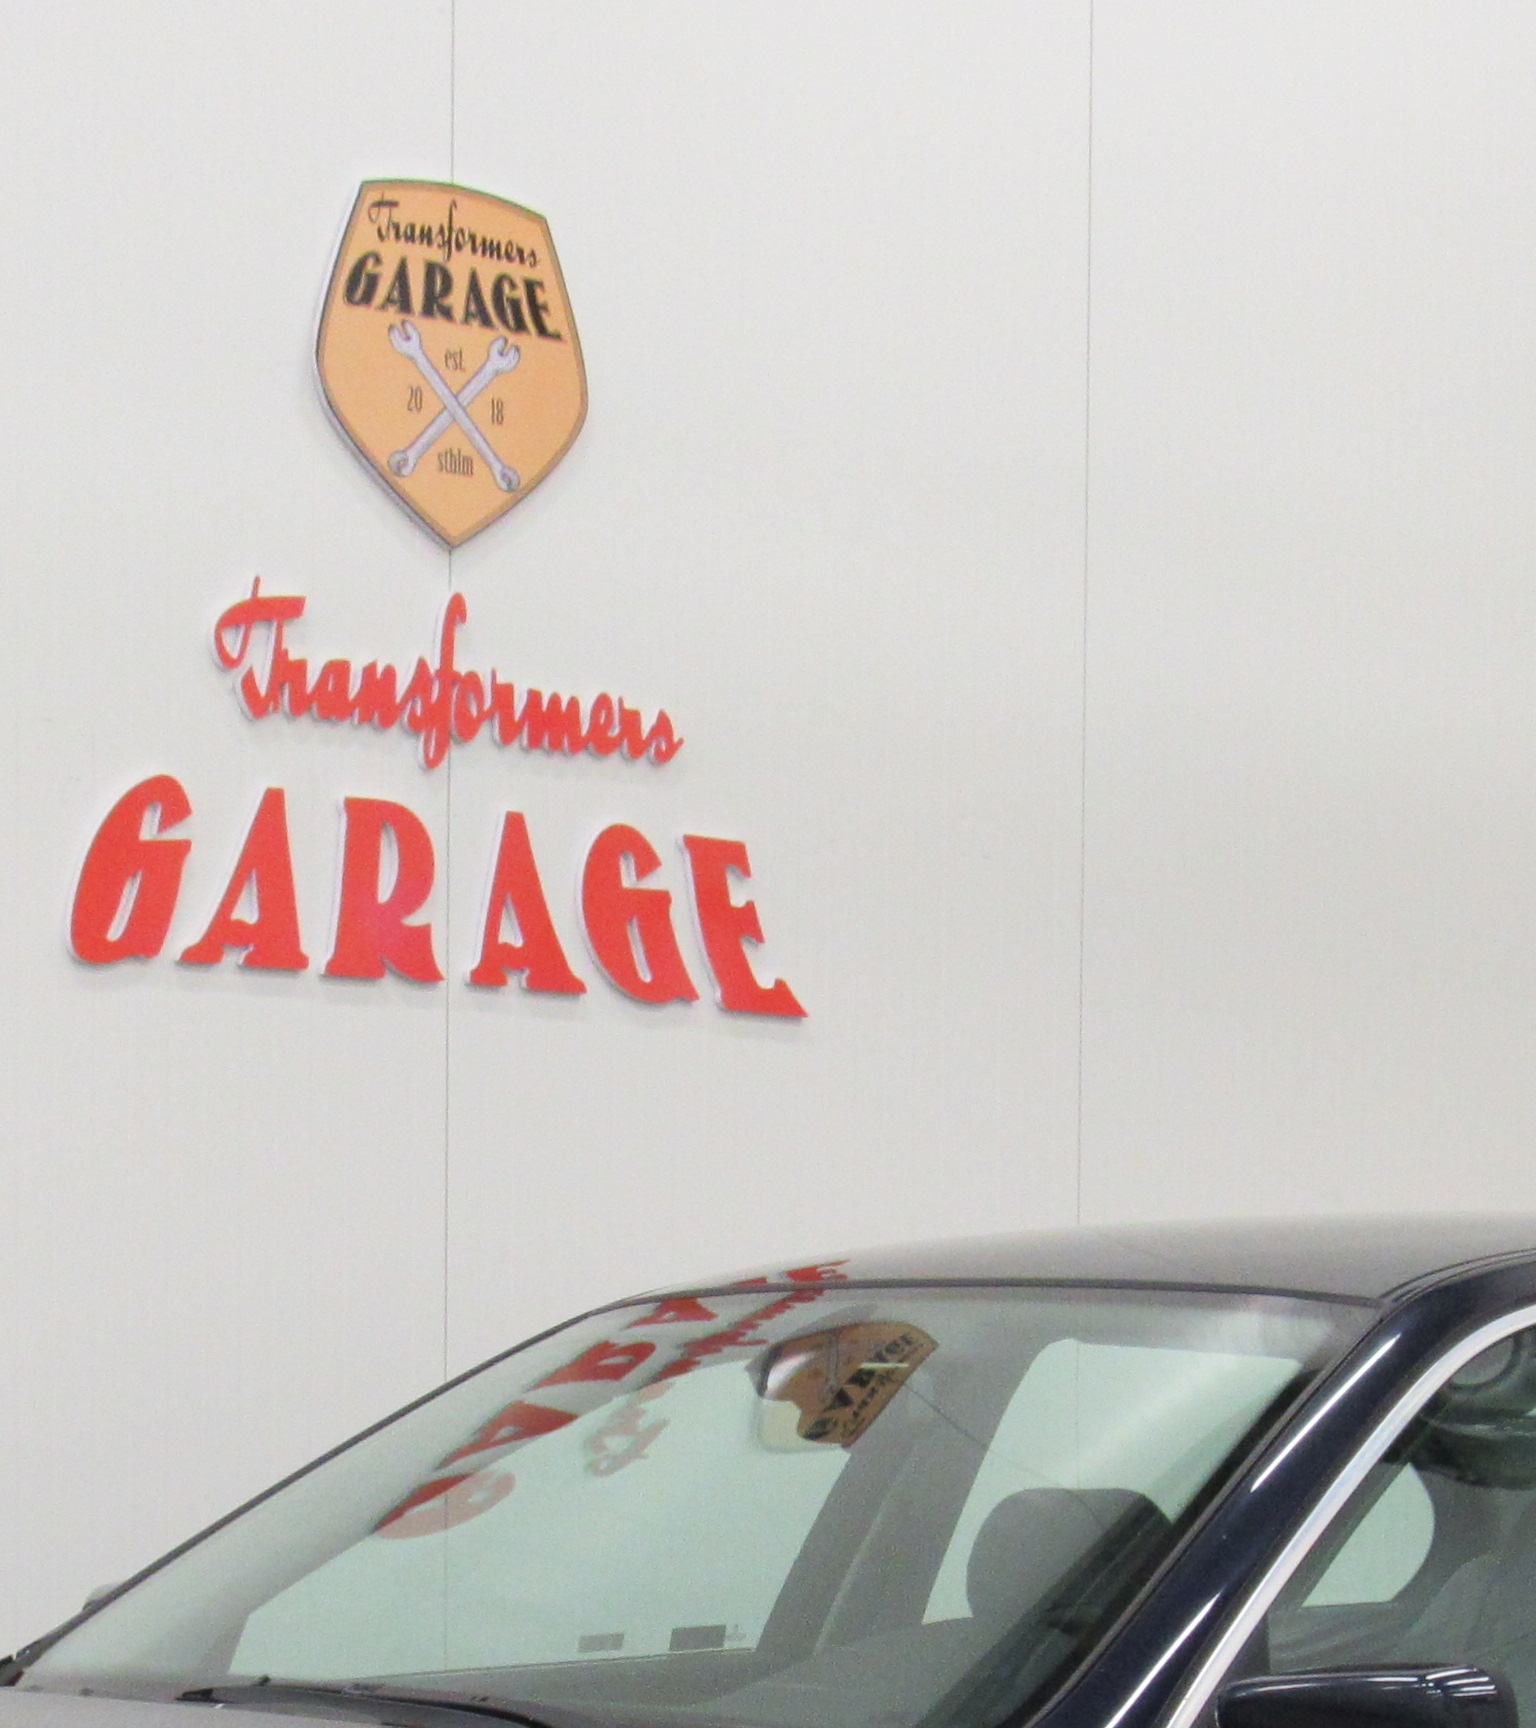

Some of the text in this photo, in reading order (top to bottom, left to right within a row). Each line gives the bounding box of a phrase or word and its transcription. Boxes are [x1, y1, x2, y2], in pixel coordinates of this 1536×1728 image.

[368, 193, 538, 268] Transformers
[344, 251, 563, 340] GARAGE
[407, 385, 504, 424] 20 18
[215, 576, 683, 769] Transformers
[70, 774, 809, 1018] GARAGE
